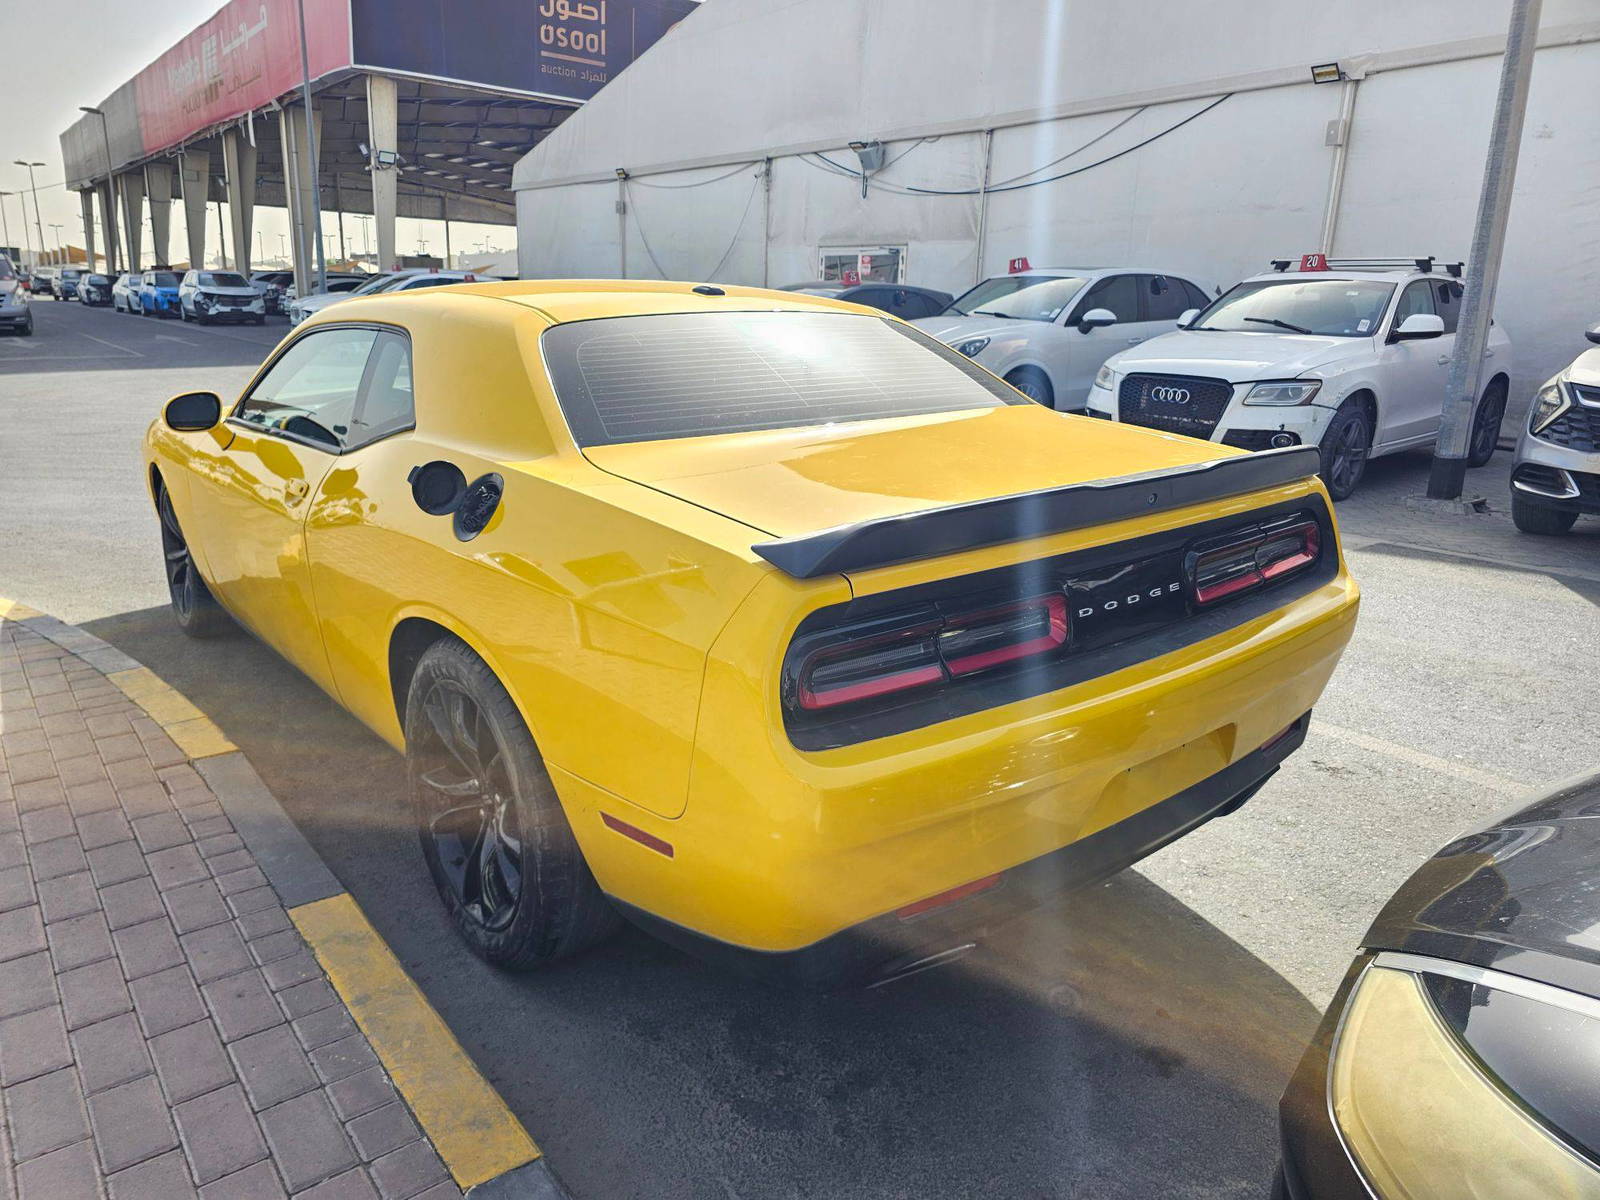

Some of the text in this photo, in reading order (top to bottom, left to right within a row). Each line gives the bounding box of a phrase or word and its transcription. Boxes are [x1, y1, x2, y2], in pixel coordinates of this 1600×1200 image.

[541, 64, 577, 78] auction
[1306, 255, 1319, 267] 20
[1079, 582, 1180, 618] DODGE
